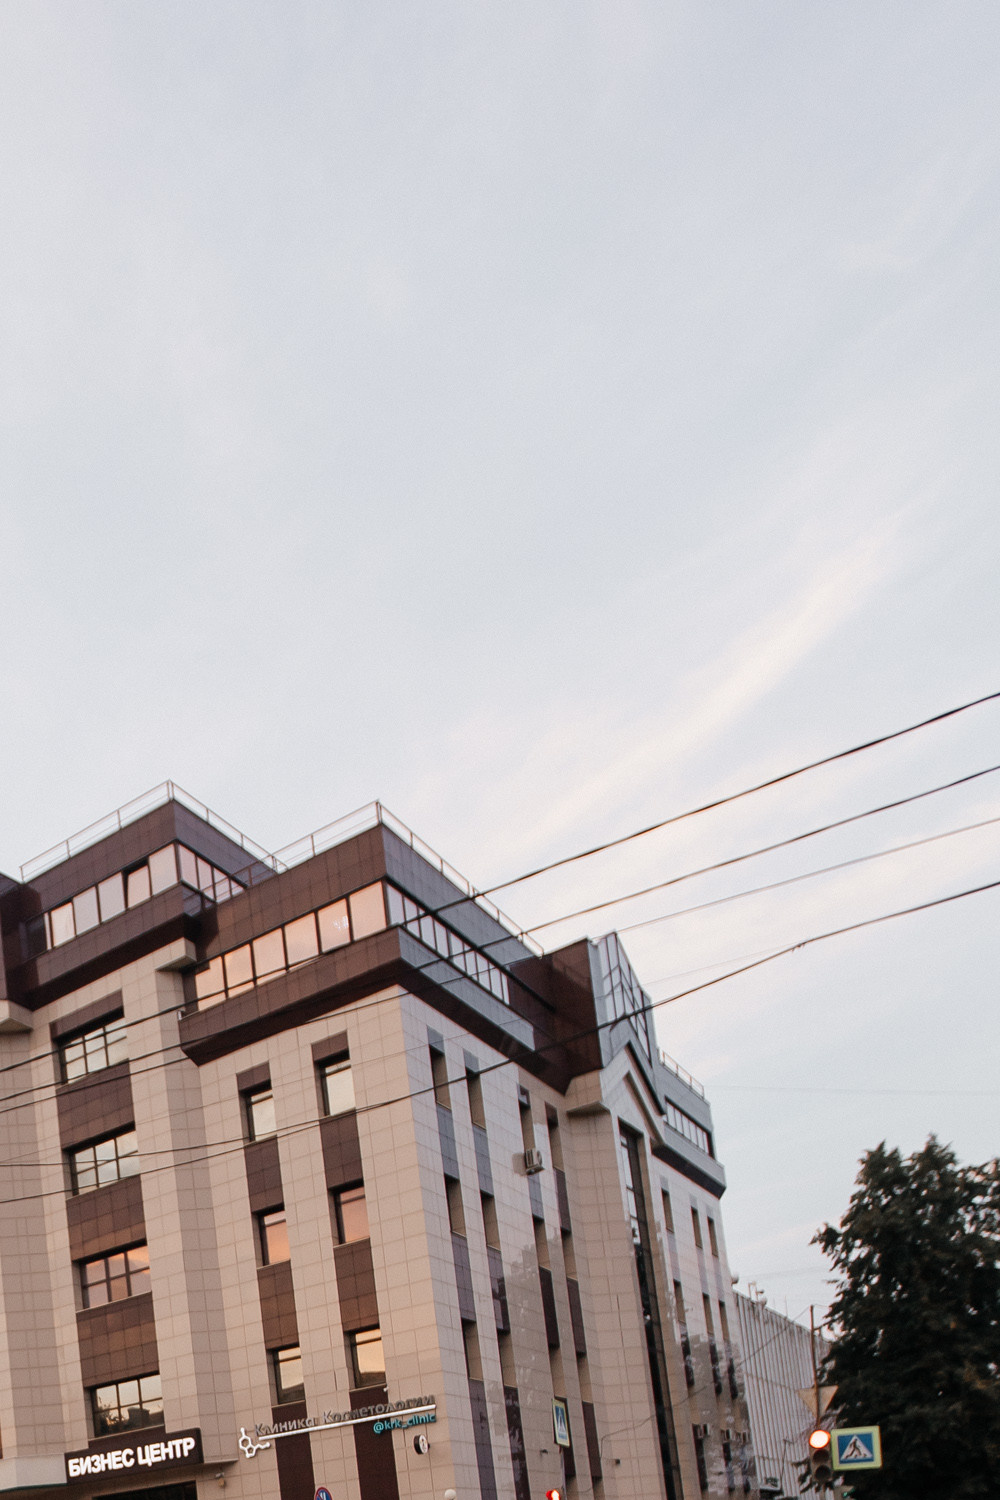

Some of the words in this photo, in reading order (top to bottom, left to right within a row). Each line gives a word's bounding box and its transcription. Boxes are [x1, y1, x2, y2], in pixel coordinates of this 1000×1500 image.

[255, 1416, 318, 1436] Клиника
[373, 1413, 437, 1434] @krk_clinic
[68, 1448, 135, 1477] БИЗНЕС
[136, 1437, 196, 1467] ЦЕНТР
